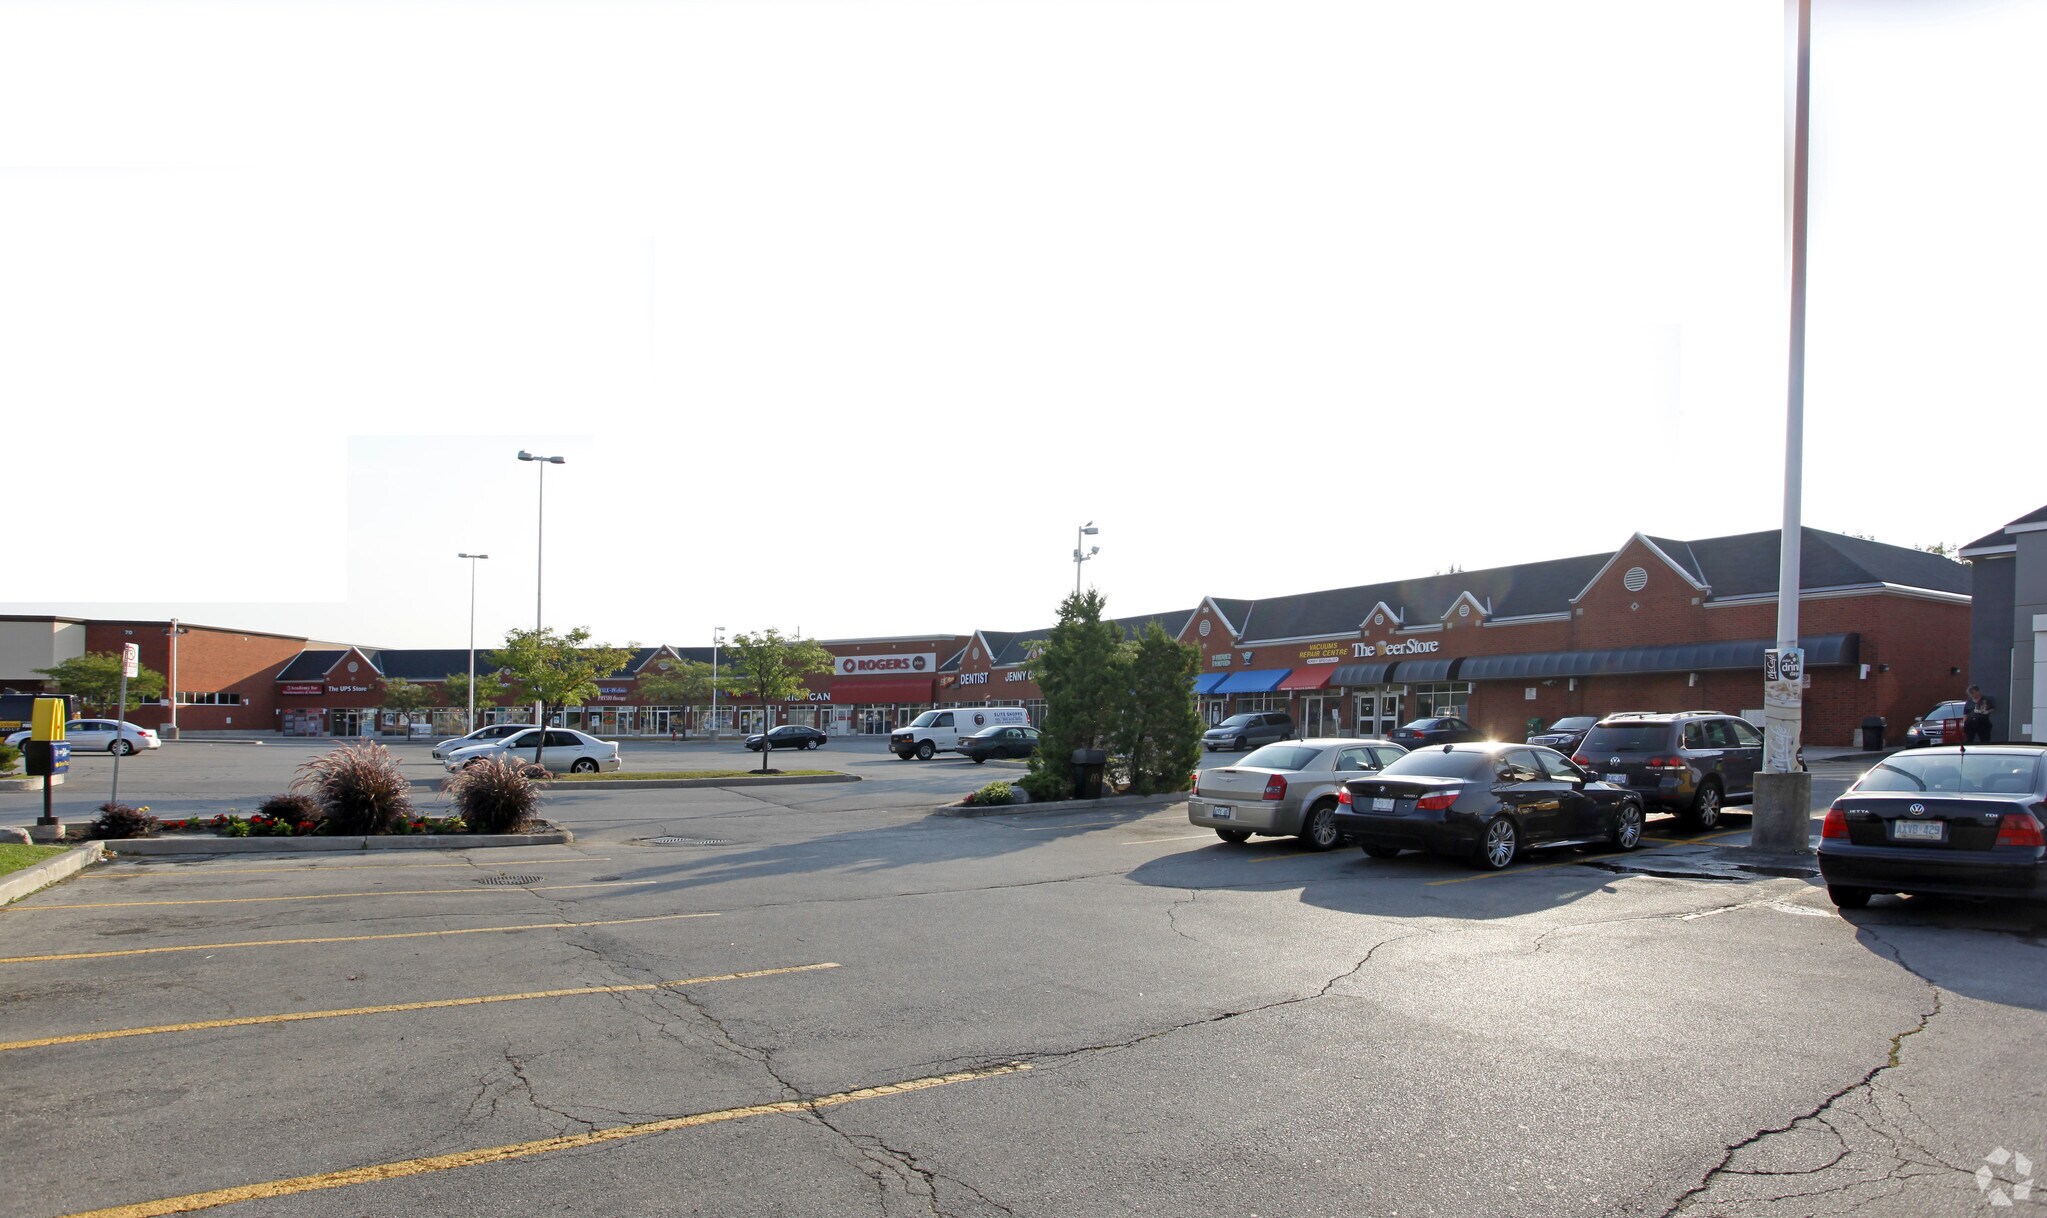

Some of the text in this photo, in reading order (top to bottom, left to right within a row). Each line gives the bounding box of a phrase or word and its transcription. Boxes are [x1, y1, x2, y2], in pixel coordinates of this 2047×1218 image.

[1310, 642, 1337, 650] VACUUMS
[1352, 639, 1438, 657] The Beer Store
[858, 658, 910, 671] ROGERS
[1782, 662, 1799, 671] drin
[960, 672, 989, 685] DENTIST
[1005, 670, 1027, 682] JENNY
